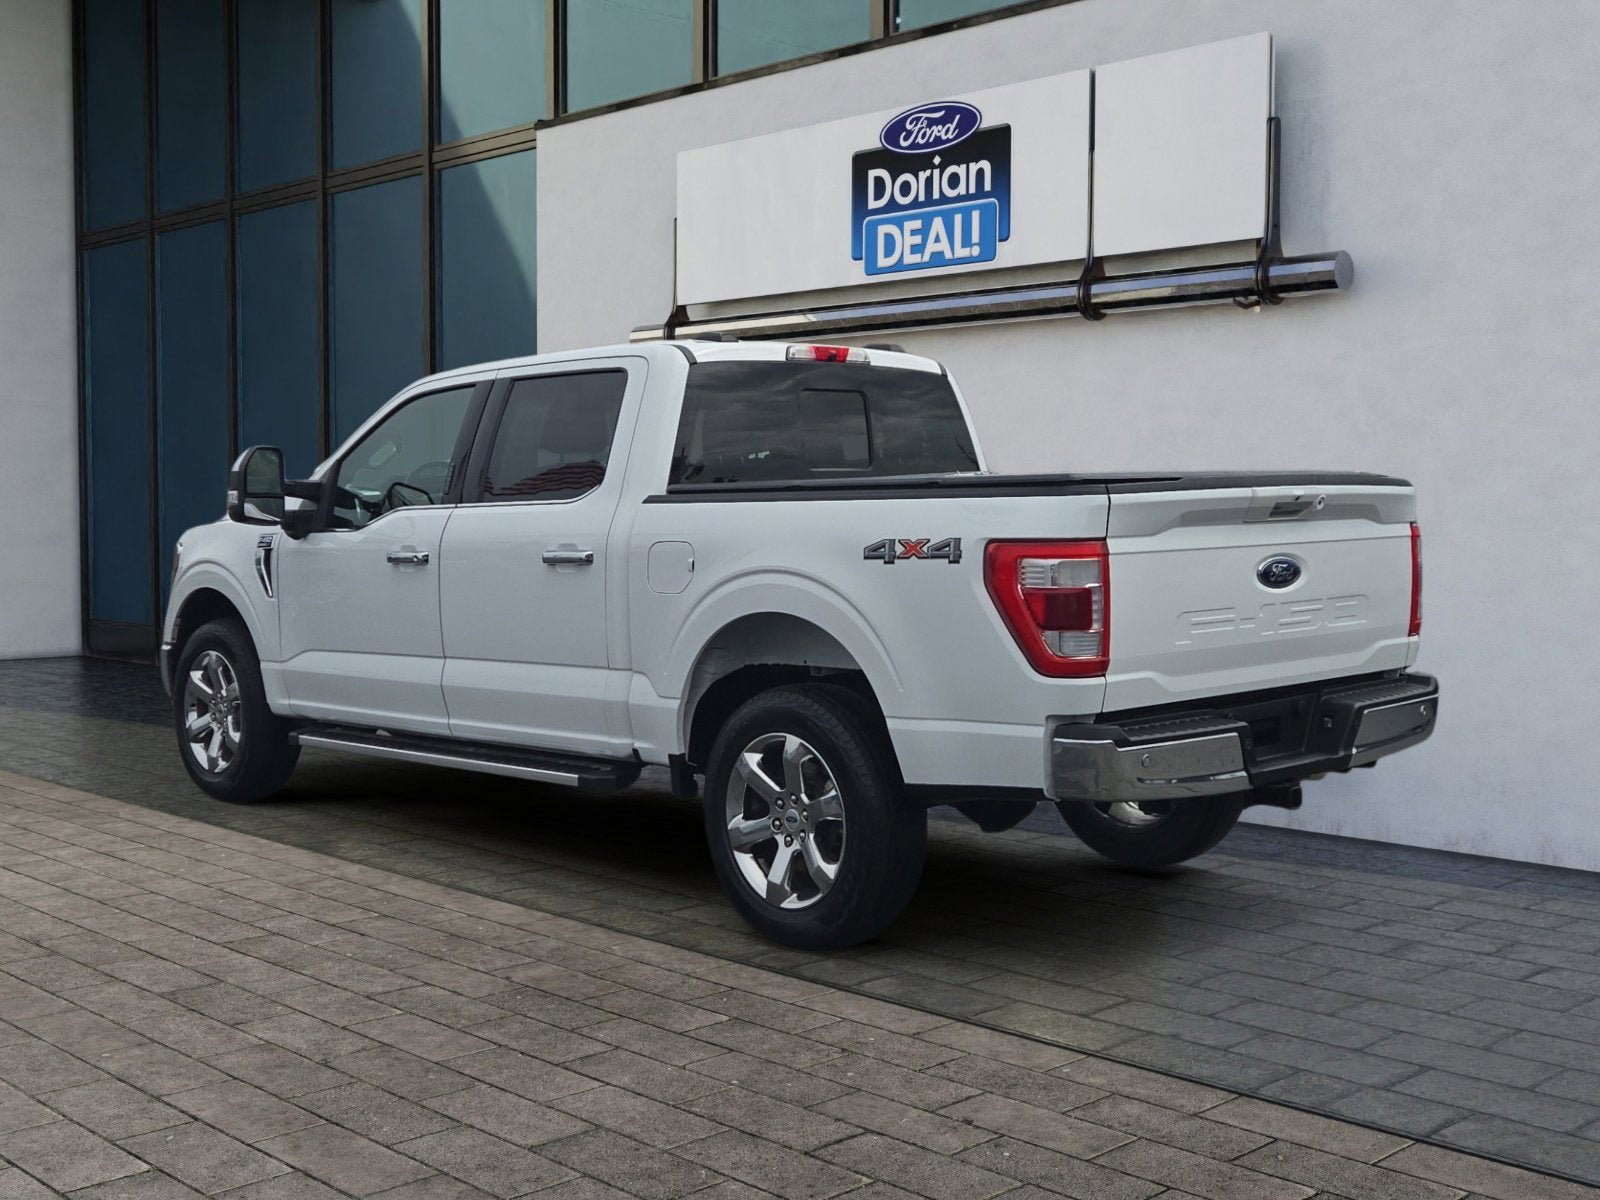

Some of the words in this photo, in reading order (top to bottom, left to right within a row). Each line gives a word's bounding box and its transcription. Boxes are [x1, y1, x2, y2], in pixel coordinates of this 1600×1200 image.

[900, 109, 961, 148] Ford
[867, 154, 992, 210] Dorian
[876, 209, 981, 269] DEAL!
[1175, 594, 1369, 646] F-150
